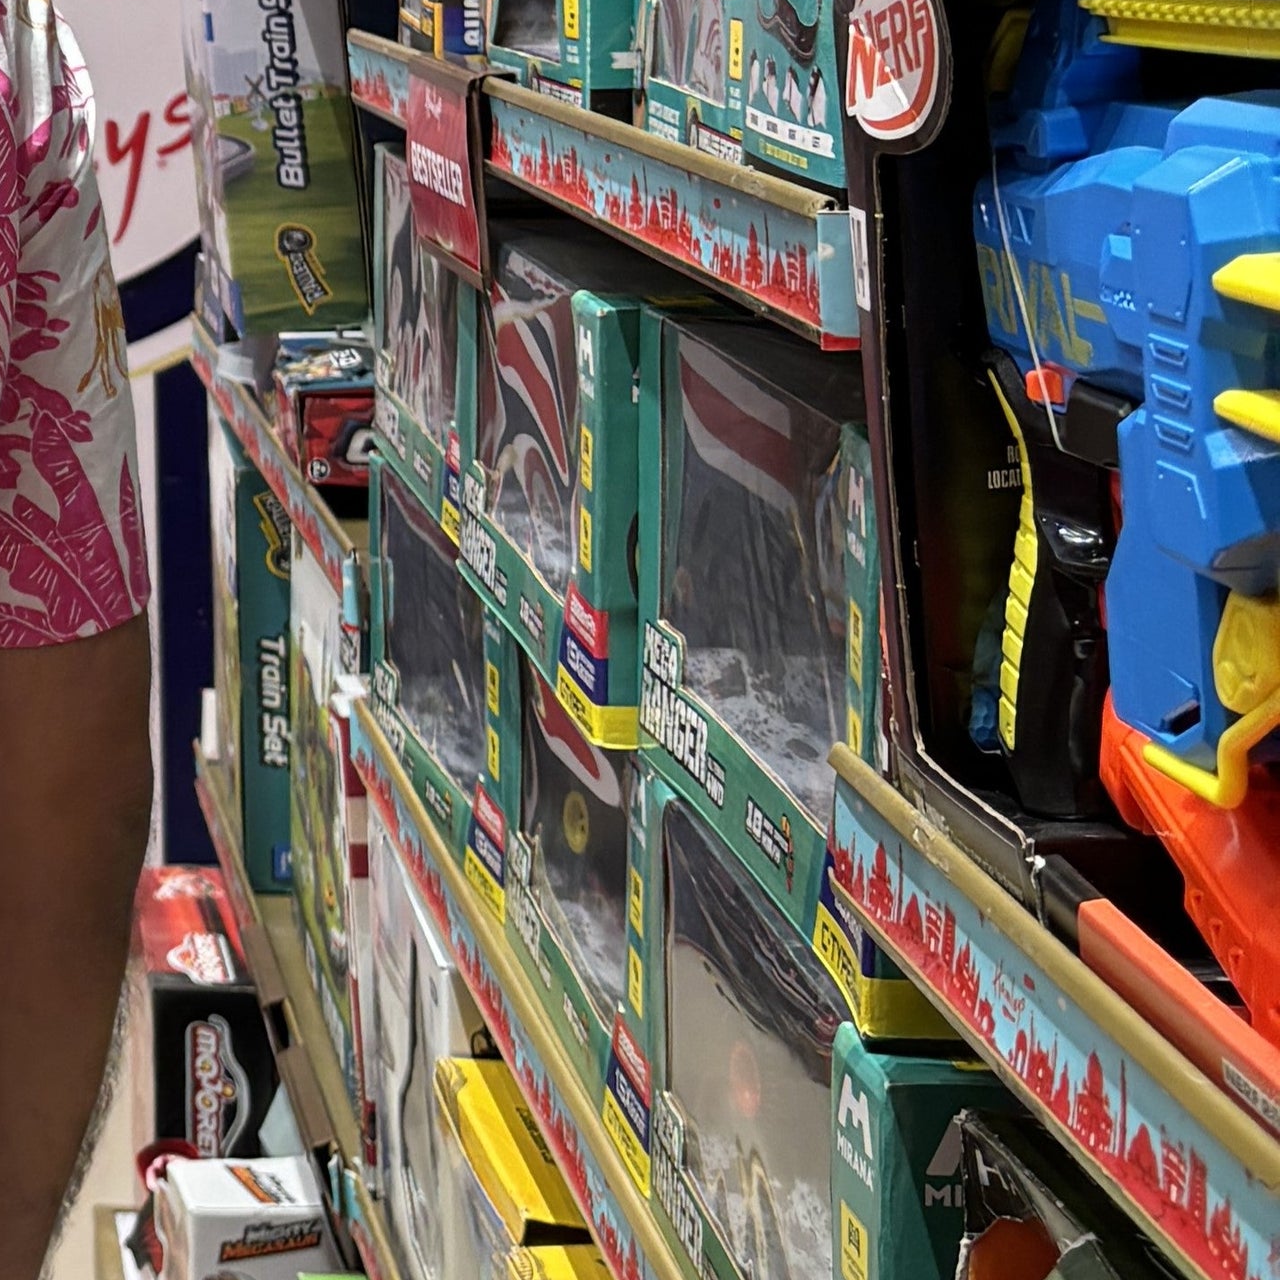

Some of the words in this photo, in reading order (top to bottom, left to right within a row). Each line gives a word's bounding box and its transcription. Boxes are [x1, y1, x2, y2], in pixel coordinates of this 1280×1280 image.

[260, 8, 303, 93] Train
[271, 95, 310, 191] Bullet
[410, 138, 467, 210] BESTSELLER
[258, 634, 288, 707] Train
[262, 707, 289, 770] Set
[641, 672, 709, 788] RANGER
[835, 1131, 875, 1192] MIRANA
